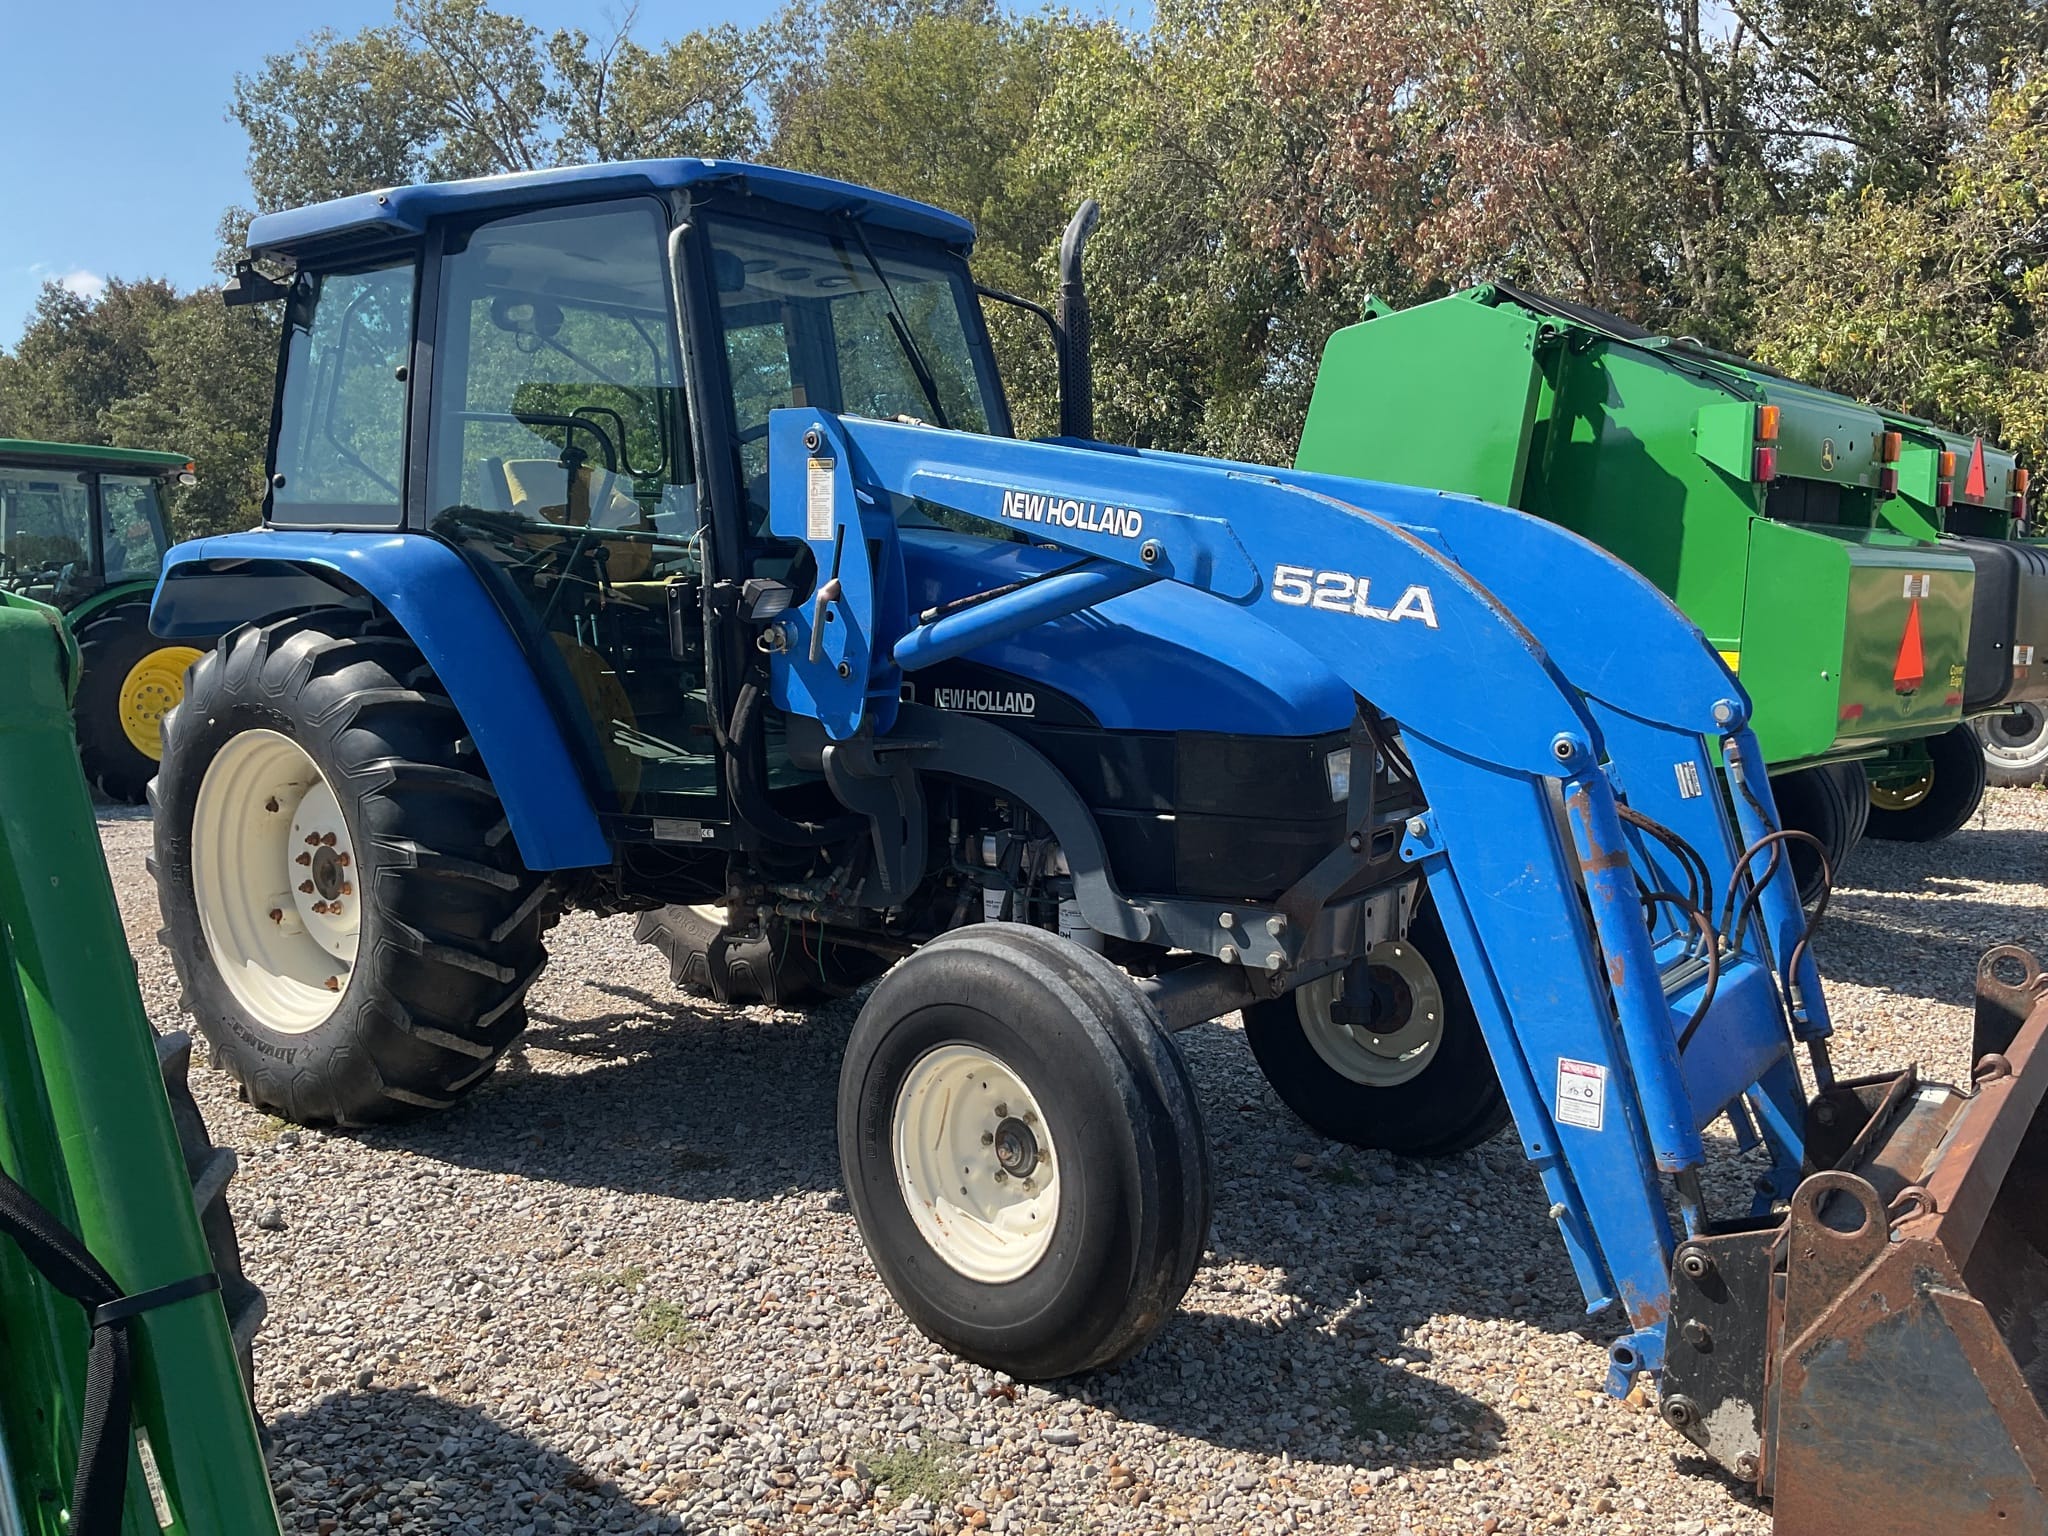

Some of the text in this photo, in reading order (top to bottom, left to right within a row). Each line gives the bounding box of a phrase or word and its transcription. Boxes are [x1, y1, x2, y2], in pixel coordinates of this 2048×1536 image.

[1001, 490, 1143, 538] NEW HOLLAND
[1271, 563, 1440, 629] 52LA
[934, 688, 965, 708] NEW
[966, 690, 1035, 714] HOLLAND
